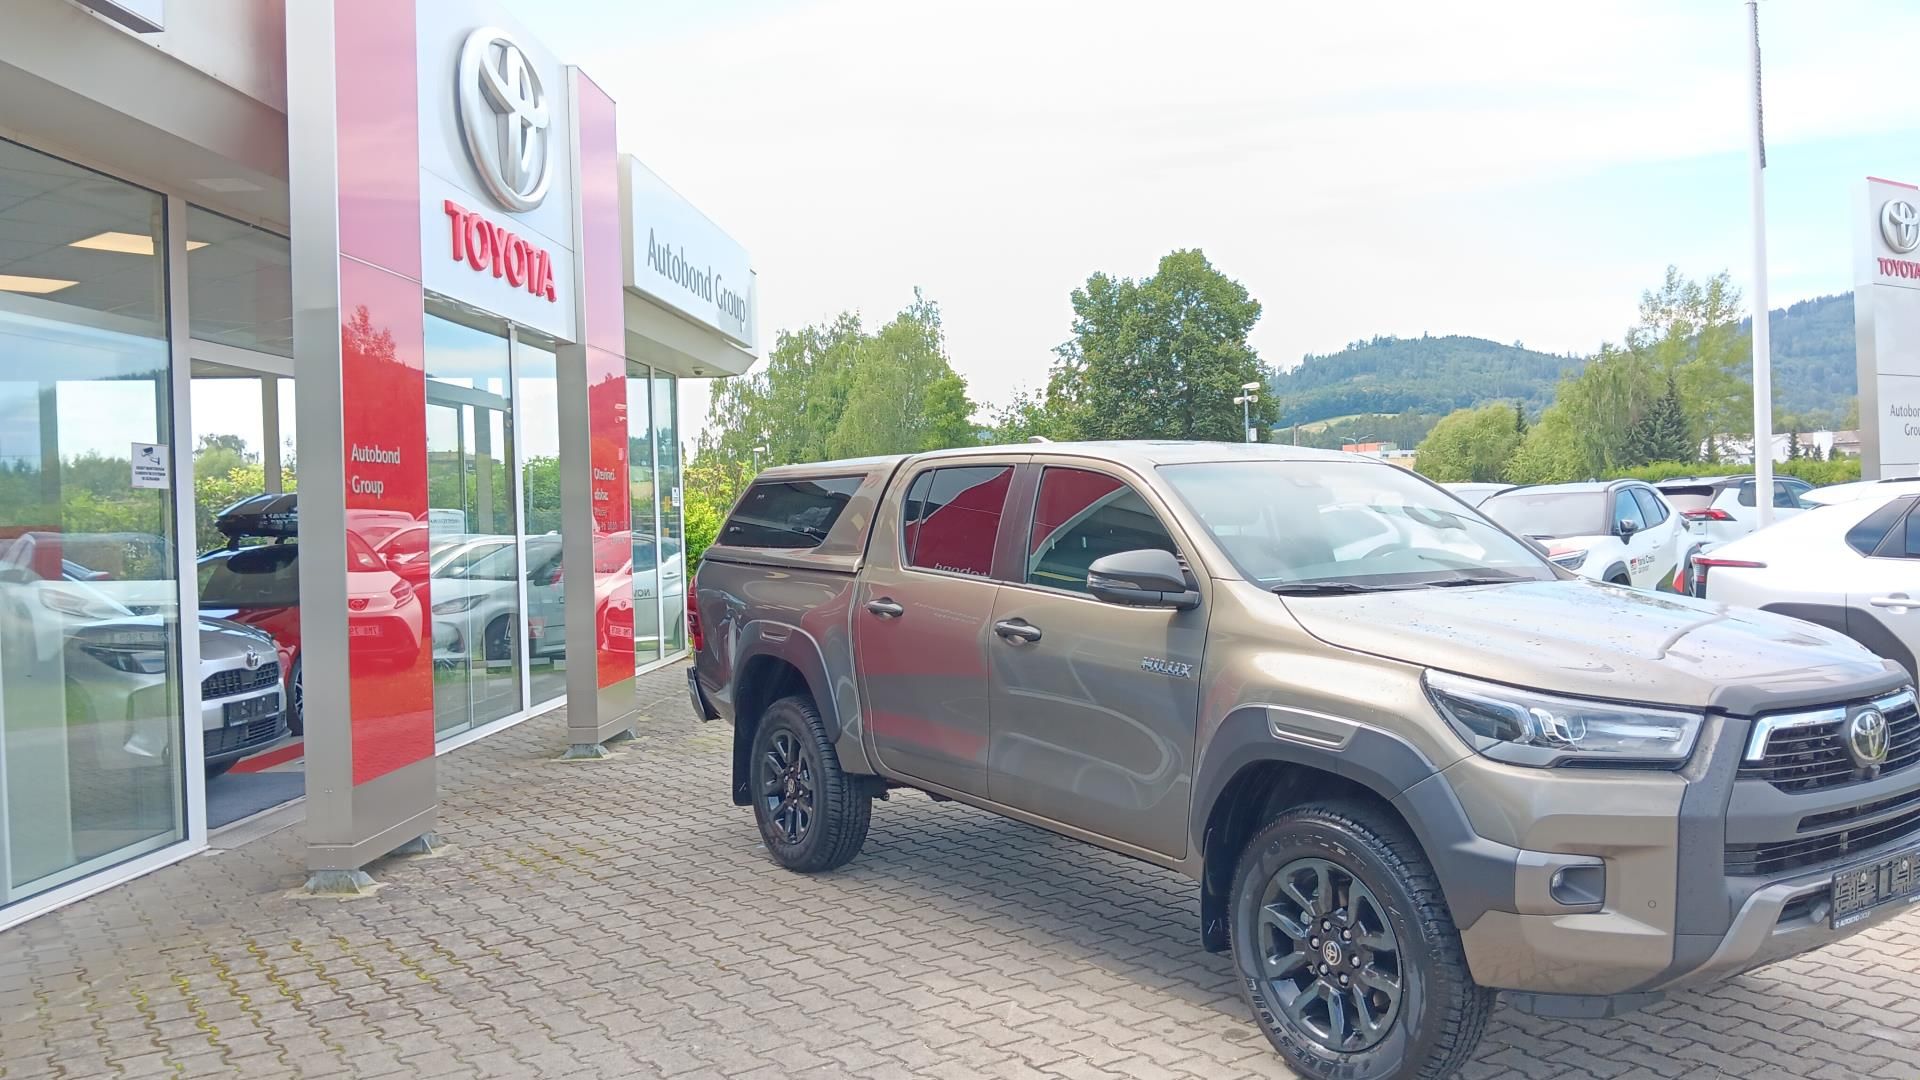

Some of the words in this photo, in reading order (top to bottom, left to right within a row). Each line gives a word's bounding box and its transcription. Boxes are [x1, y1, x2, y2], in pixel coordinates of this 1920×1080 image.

[444, 199, 557, 303] TOYOTA
[1877, 256, 1920, 279] TOYOTA
[647, 226, 713, 303] Autobond
[715, 273, 746, 333] Group
[1904, 422, 1920, 437] Gro
[351, 442, 401, 465] Autobond
[351, 474, 385, 500] Group
[1140, 656, 1193, 679] HILUX
